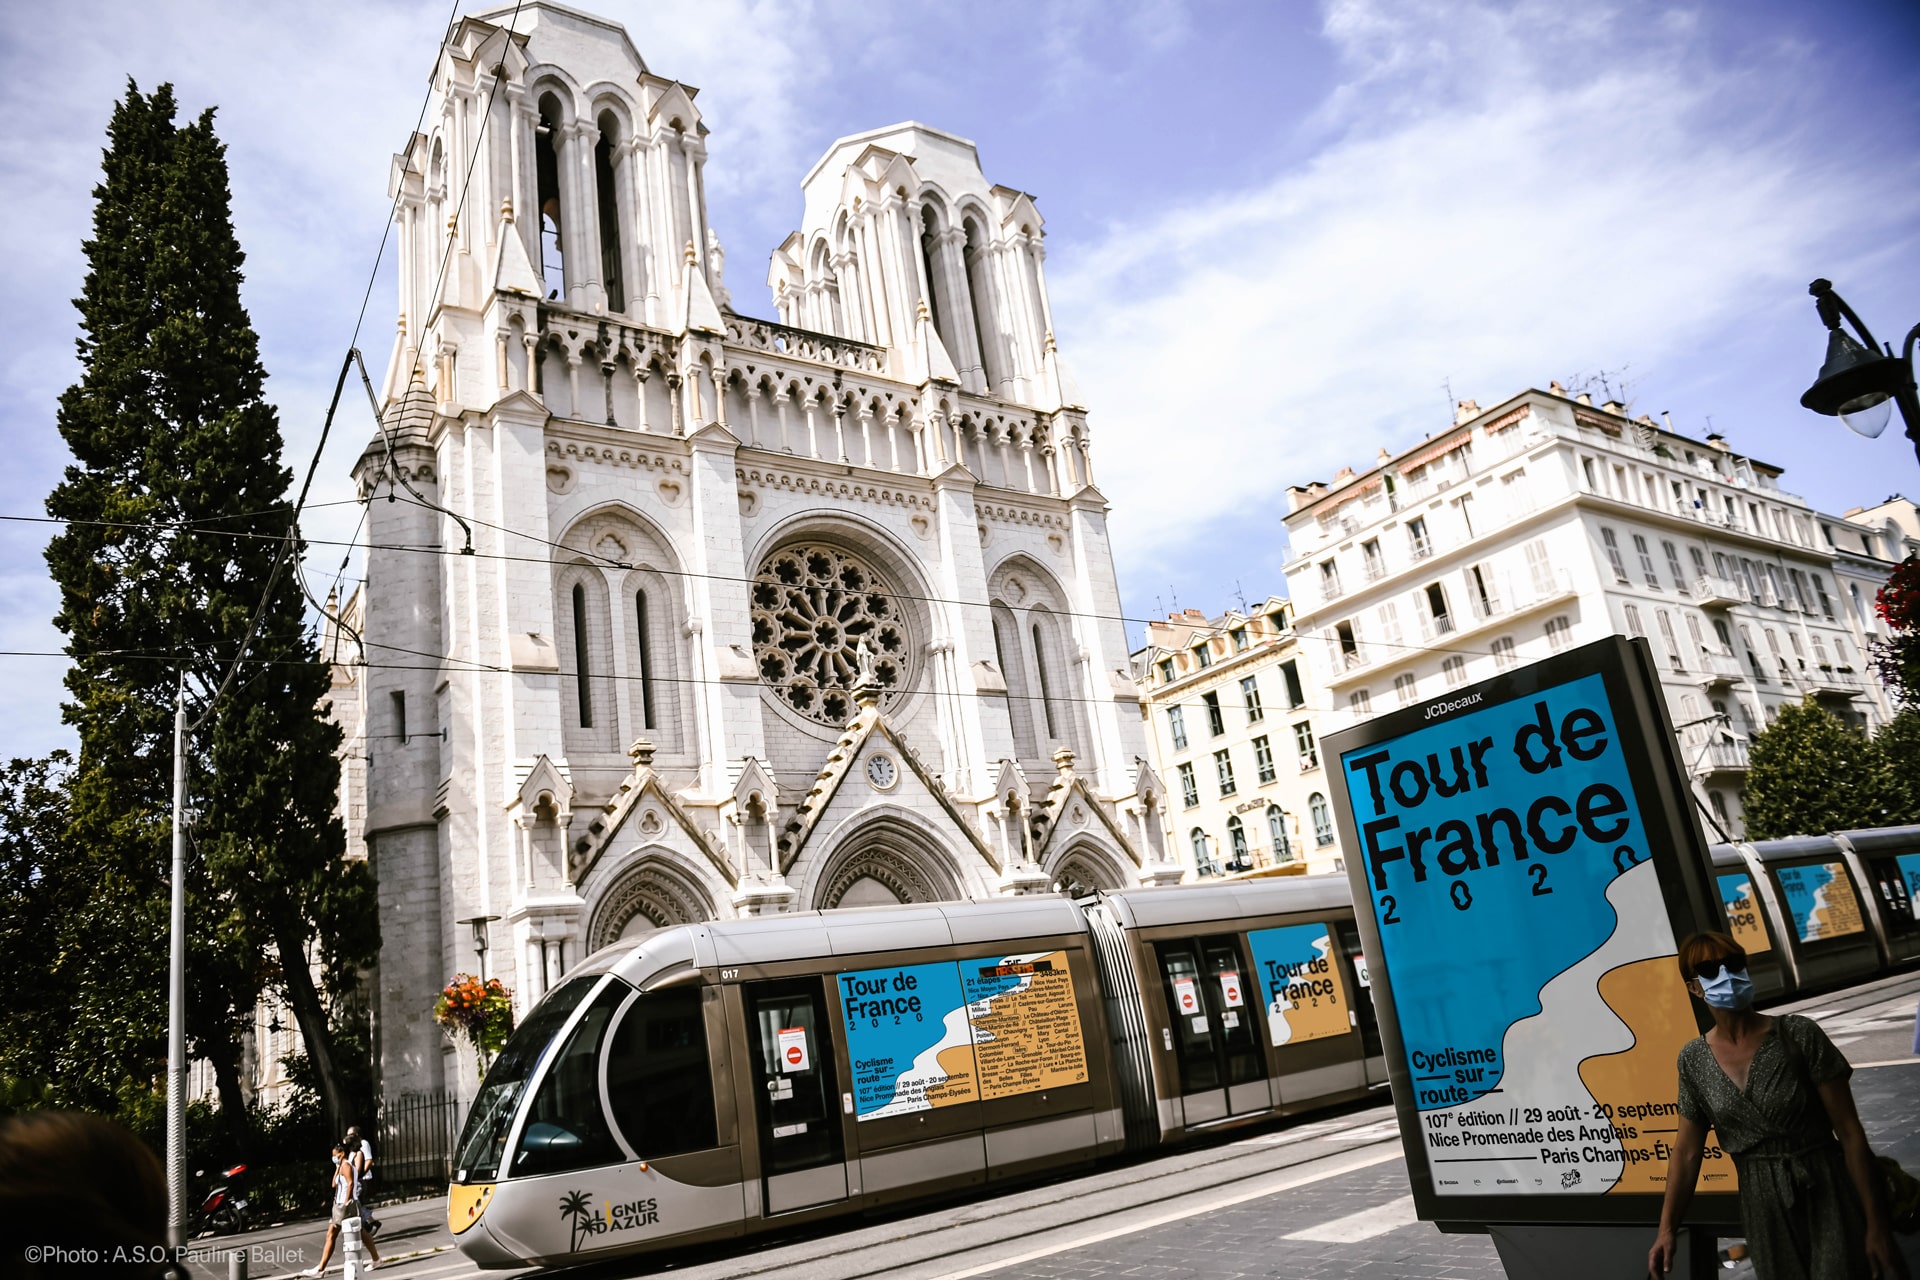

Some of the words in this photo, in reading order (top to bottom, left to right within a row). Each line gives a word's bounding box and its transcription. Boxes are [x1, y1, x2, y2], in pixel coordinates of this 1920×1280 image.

[1424, 693, 1483, 720] JCDecaux
[1350, 736, 1494, 815] Tour
[1513, 701, 1608, 774] de
[1363, 783, 1630, 891] France
[1733, 896, 1751, 910] de
[722, 970, 738, 979] 017
[1264, 960, 1304, 980] Tour
[1308, 955, 1329, 974] de
[842, 976, 888, 996] Tour
[892, 971, 918, 992] de
[976, 976, 1000, 986] étapes
[1269, 978, 1334, 1002] France
[845, 996, 921, 1020] France
[855, 1057, 894, 1070] Cyclisme
[1412, 1048, 1496, 1072] Cyclisme
[858, 1074, 880, 1084] route
[874, 1084, 895, 1093] édition
[938, 1072, 970, 1082] septembre
[1456, 1066, 1484, 1084] sur
[875, 1090, 910, 1100] Promenade
[922, 1084, 945, 1093] Anglais
[906, 1096, 922, 1104] Paris
[923, 1087, 971, 1100] Champs-Élysées
[1420, 1085, 1468, 1104] route
[1458, 1110, 1505, 1127] édition
[1524, 1108, 1542, 1123] 29
[1546, 1106, 1582, 1122] août
[1592, 1103, 1614, 1119] 20
[1428, 1132, 1460, 1148] Nice
[1462, 1128, 1544, 1146] Promenade
[1547, 1127, 1575, 1142] des
[1579, 1123, 1638, 1144] Anglais
[1540, 1148, 1580, 1164] Paris
